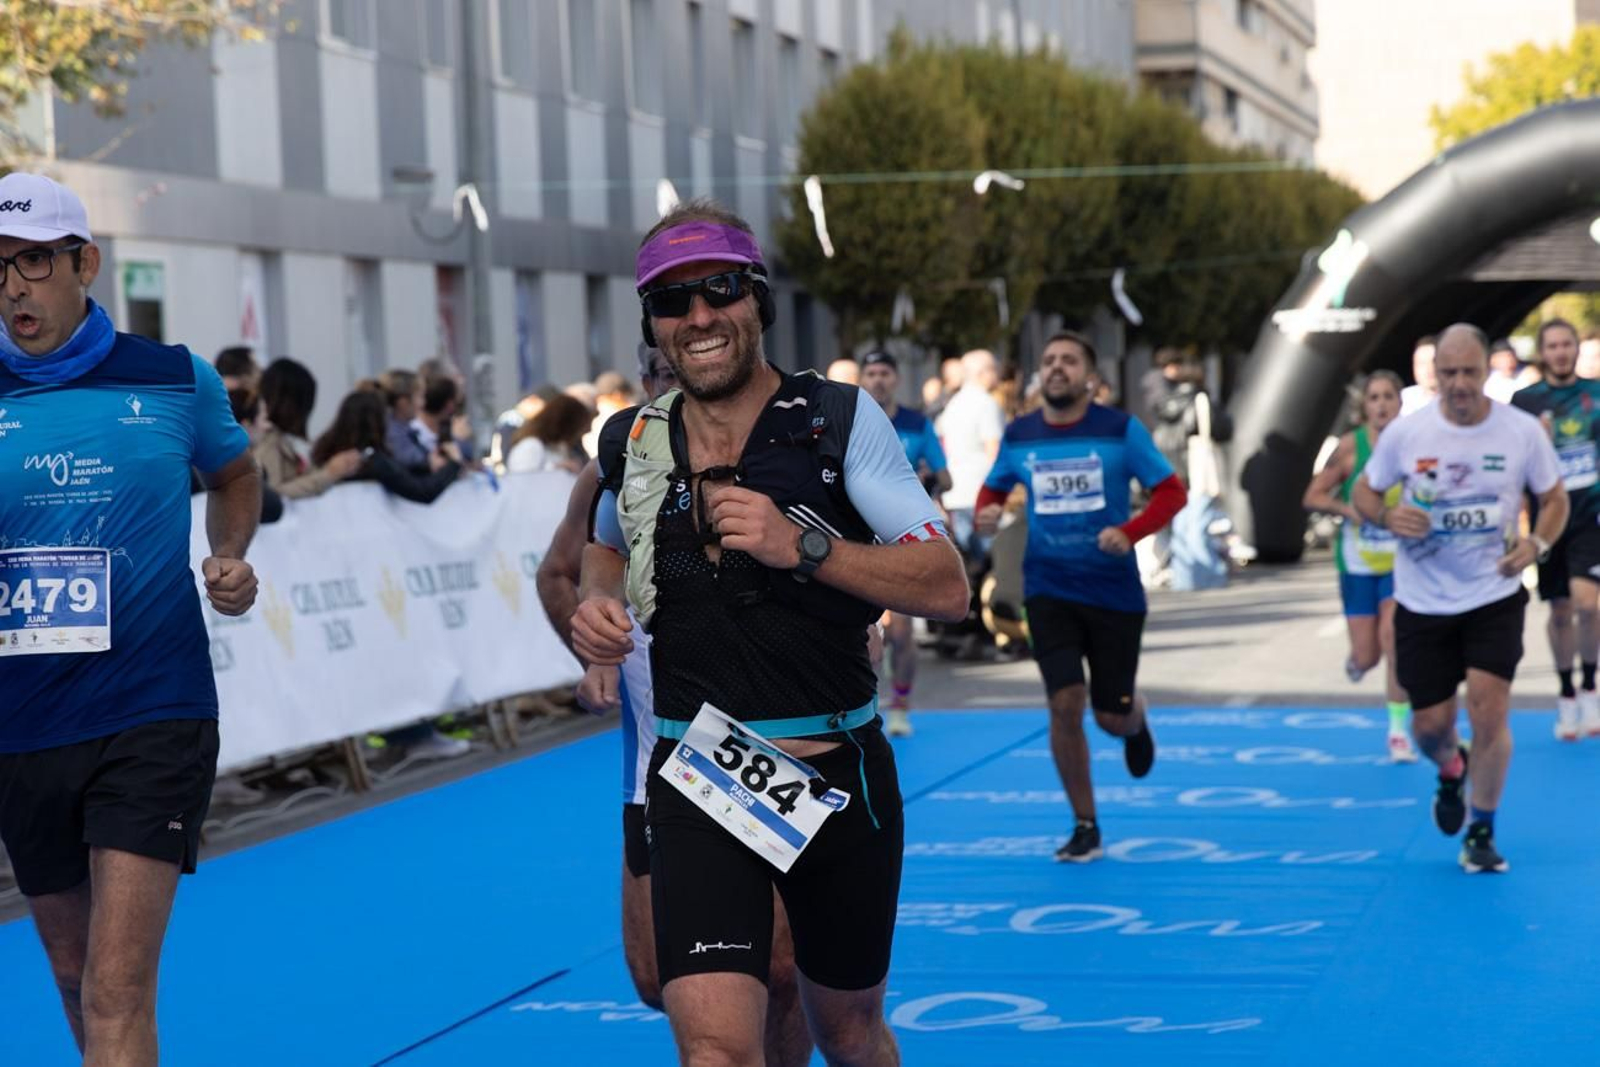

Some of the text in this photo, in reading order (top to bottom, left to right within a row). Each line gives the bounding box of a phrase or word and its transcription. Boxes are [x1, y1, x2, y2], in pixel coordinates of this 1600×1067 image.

[72, 465, 114, 476] MARATÓN
[74, 458, 101, 467] MEDIA
[70, 477, 91, 486] JAÉN
[1047, 475, 1089, 494] 396
[1442, 510, 1487, 530] 603
[0, 577, 98, 616] 2479
[26, 615, 49, 624] JUAN
[713, 734, 806, 816] 584
[729, 783, 756, 807] PACHI
